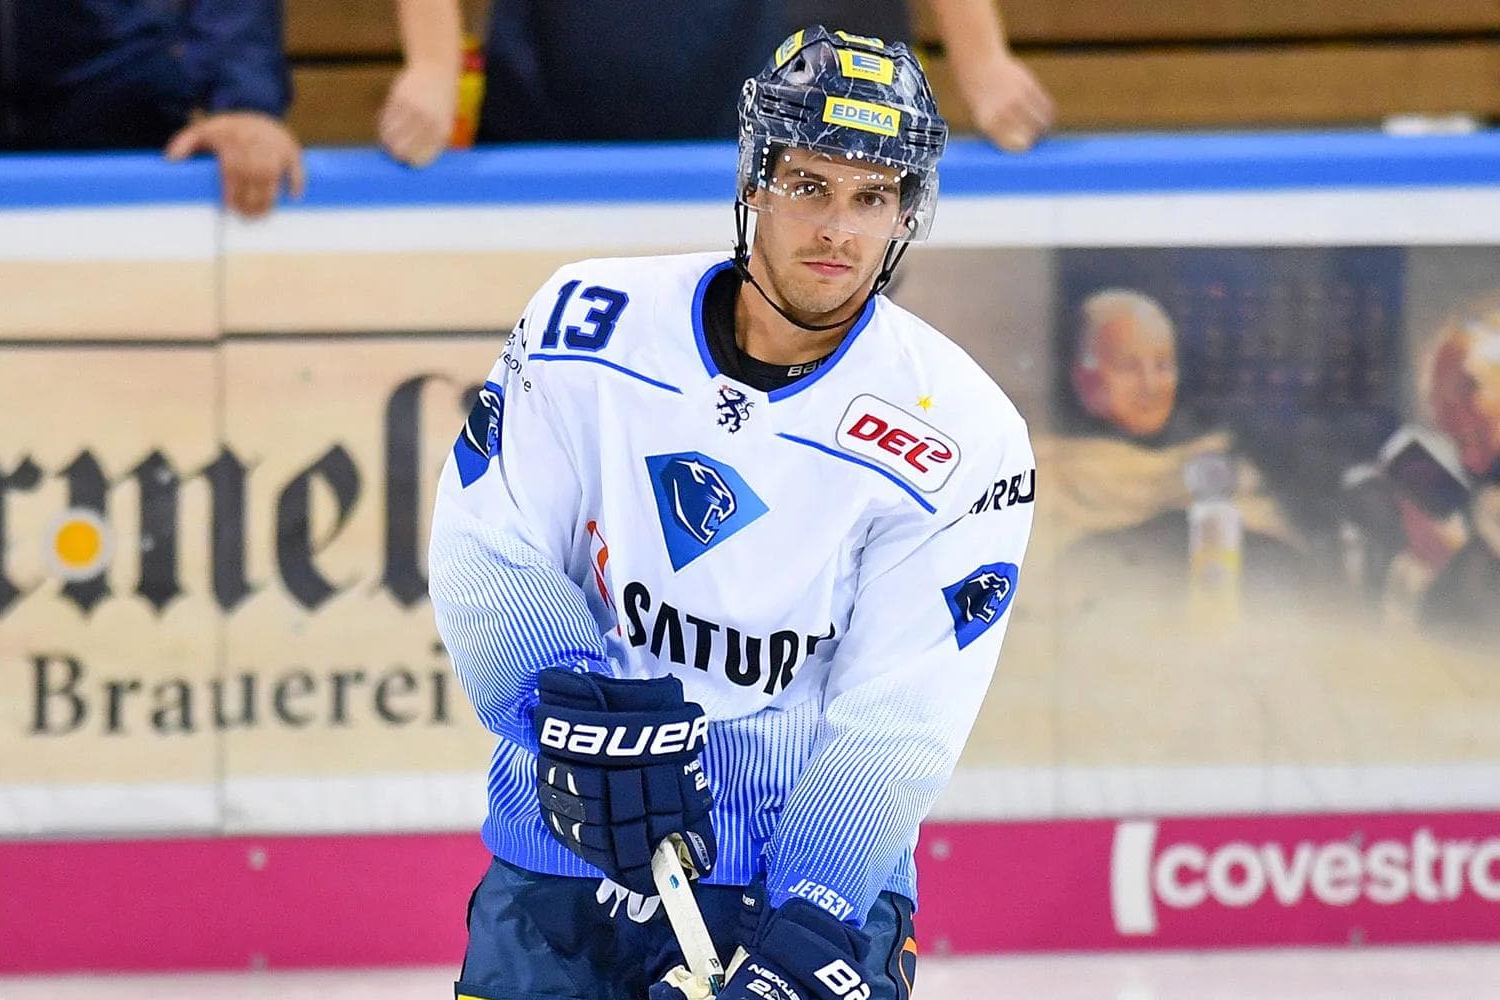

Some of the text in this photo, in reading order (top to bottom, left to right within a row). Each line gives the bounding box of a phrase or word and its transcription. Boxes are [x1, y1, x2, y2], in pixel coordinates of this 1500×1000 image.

[832, 103, 894, 128] EDEKA
[540, 279, 630, 352] 13
[28, 642, 457, 736] Brauerei
[539, 716, 708, 757] BAUER
[1155, 827, 1500, 908] covestro
